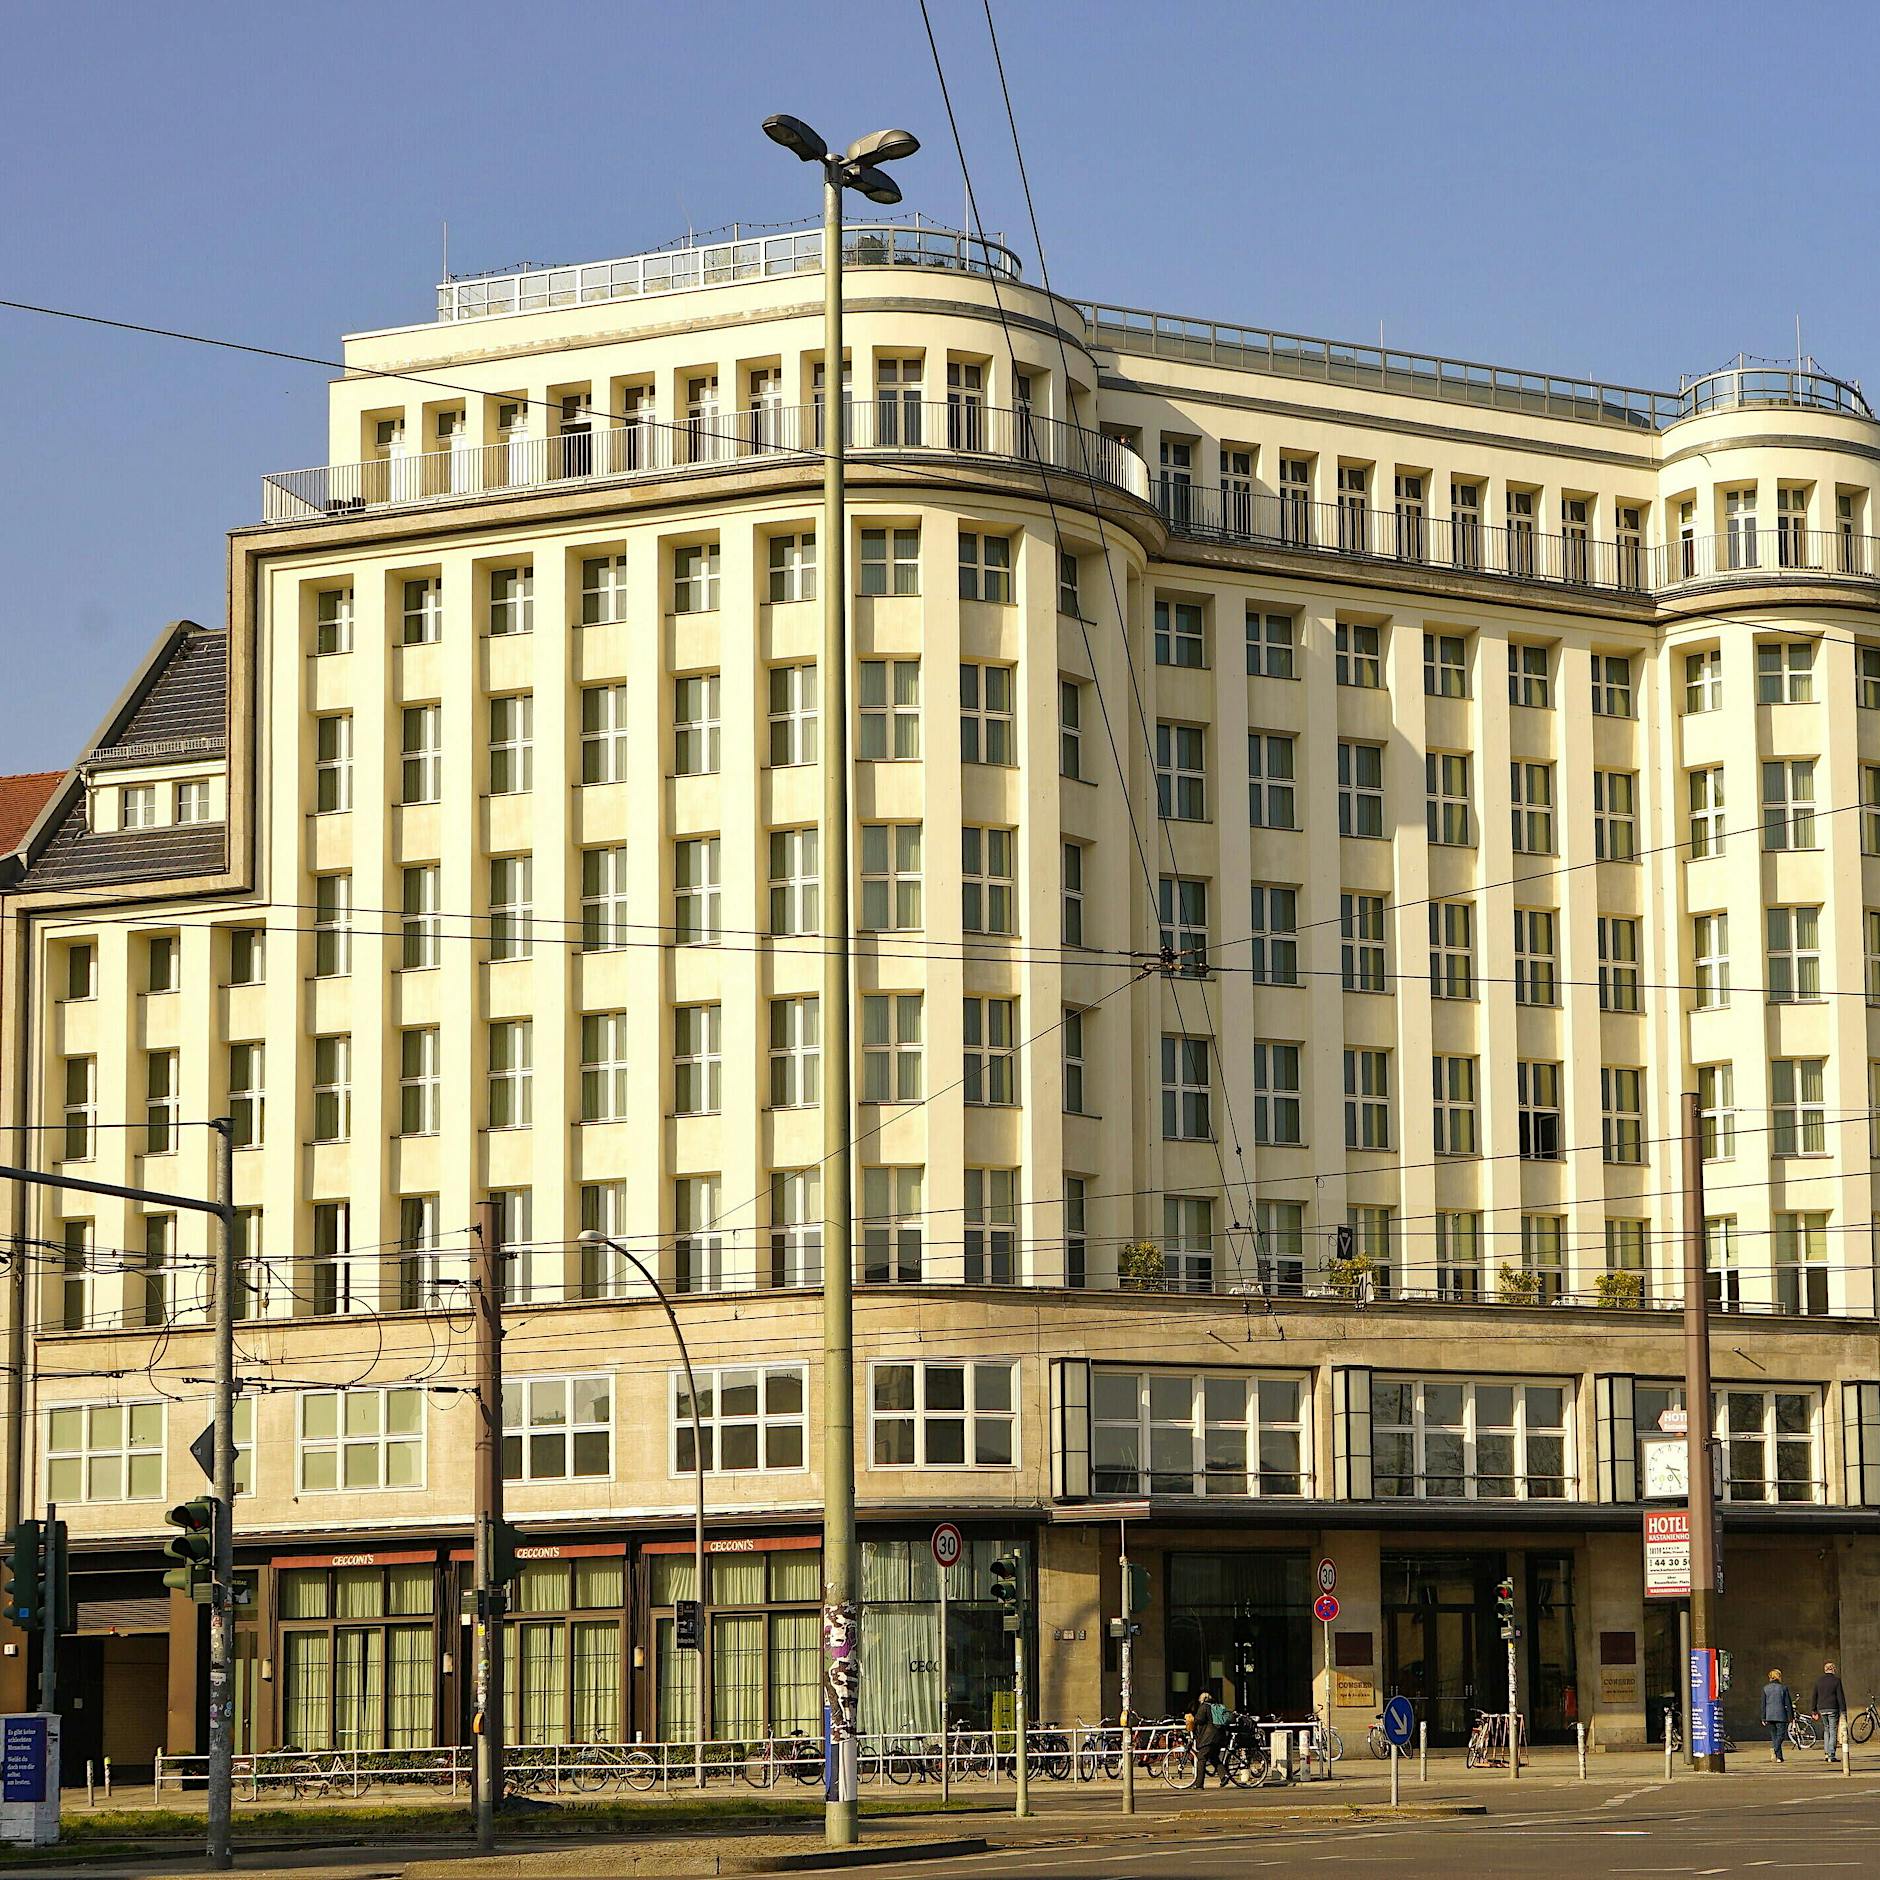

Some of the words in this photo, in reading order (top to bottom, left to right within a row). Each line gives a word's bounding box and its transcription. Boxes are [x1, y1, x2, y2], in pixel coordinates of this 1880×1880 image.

[1648, 1516, 1688, 1533] HOTEL
[710, 1539, 754, 1551] CECCONI'S
[939, 1536, 956, 1555] 30
[517, 1546, 560, 1558] CECCONI'S
[332, 1554, 374, 1566] CECCONI'S
[1668, 1558, 1680, 1566] 30
[1323, 1569, 1334, 1584] 30
